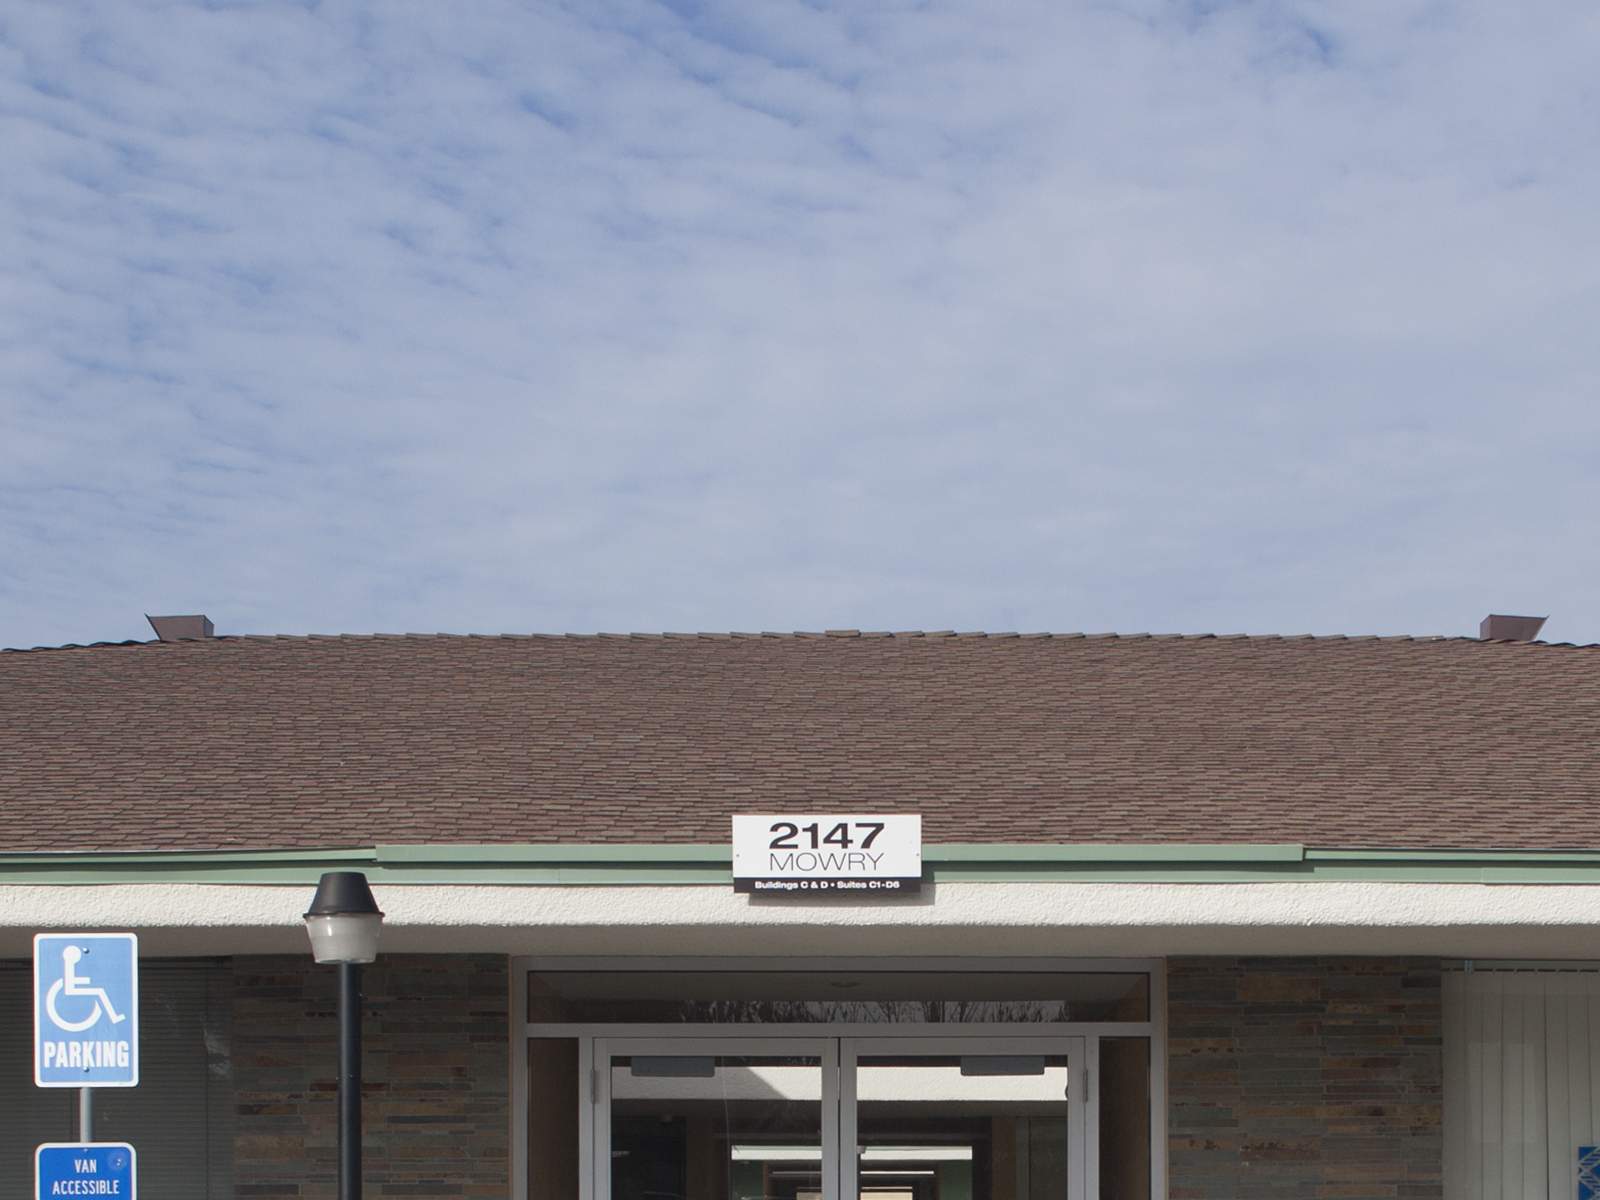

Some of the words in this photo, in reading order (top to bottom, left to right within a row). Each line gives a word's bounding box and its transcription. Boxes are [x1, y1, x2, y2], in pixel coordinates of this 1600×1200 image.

[769, 822, 885, 849] 2147
[770, 852, 885, 872] MOWRY
[755, 881, 799, 891] Buildings
[800, 881, 808, 889] C
[810, 881, 818, 889] &
[820, 881, 828, 889] D
[837, 881, 867, 889] Suites
[43, 1041, 130, 1068] PARKING
[74, 1159, 97, 1173] VAN
[52, 1180, 120, 1195] ACCESSIBLE
